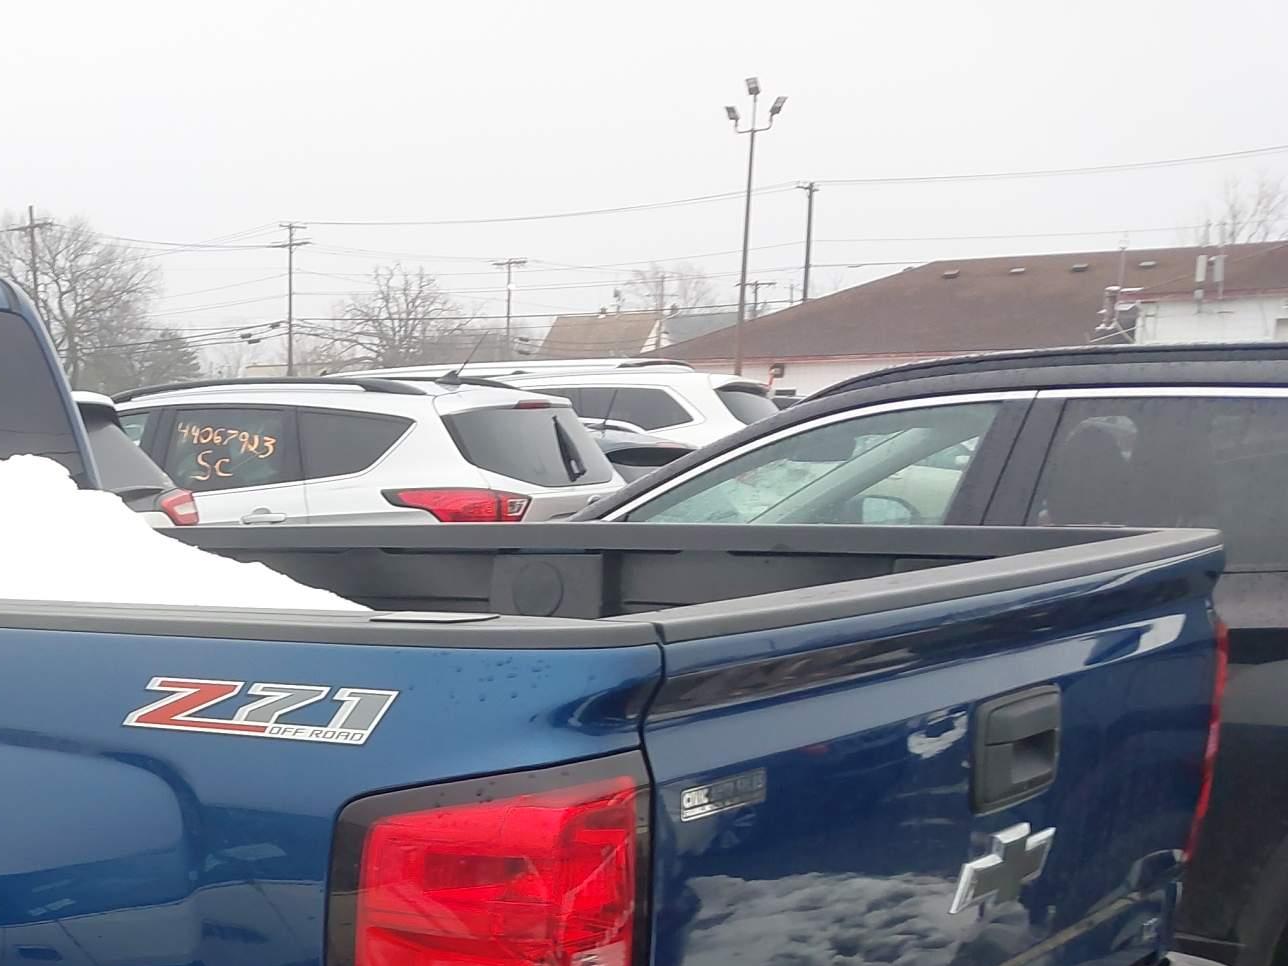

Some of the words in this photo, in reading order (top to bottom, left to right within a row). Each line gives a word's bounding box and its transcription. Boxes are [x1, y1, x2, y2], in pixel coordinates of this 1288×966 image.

[190, 450, 233, 481] SC
[122, 676, 400, 737] Z71
[269, 725, 308, 738] OFF
[308, 729, 365, 742] ROAD
